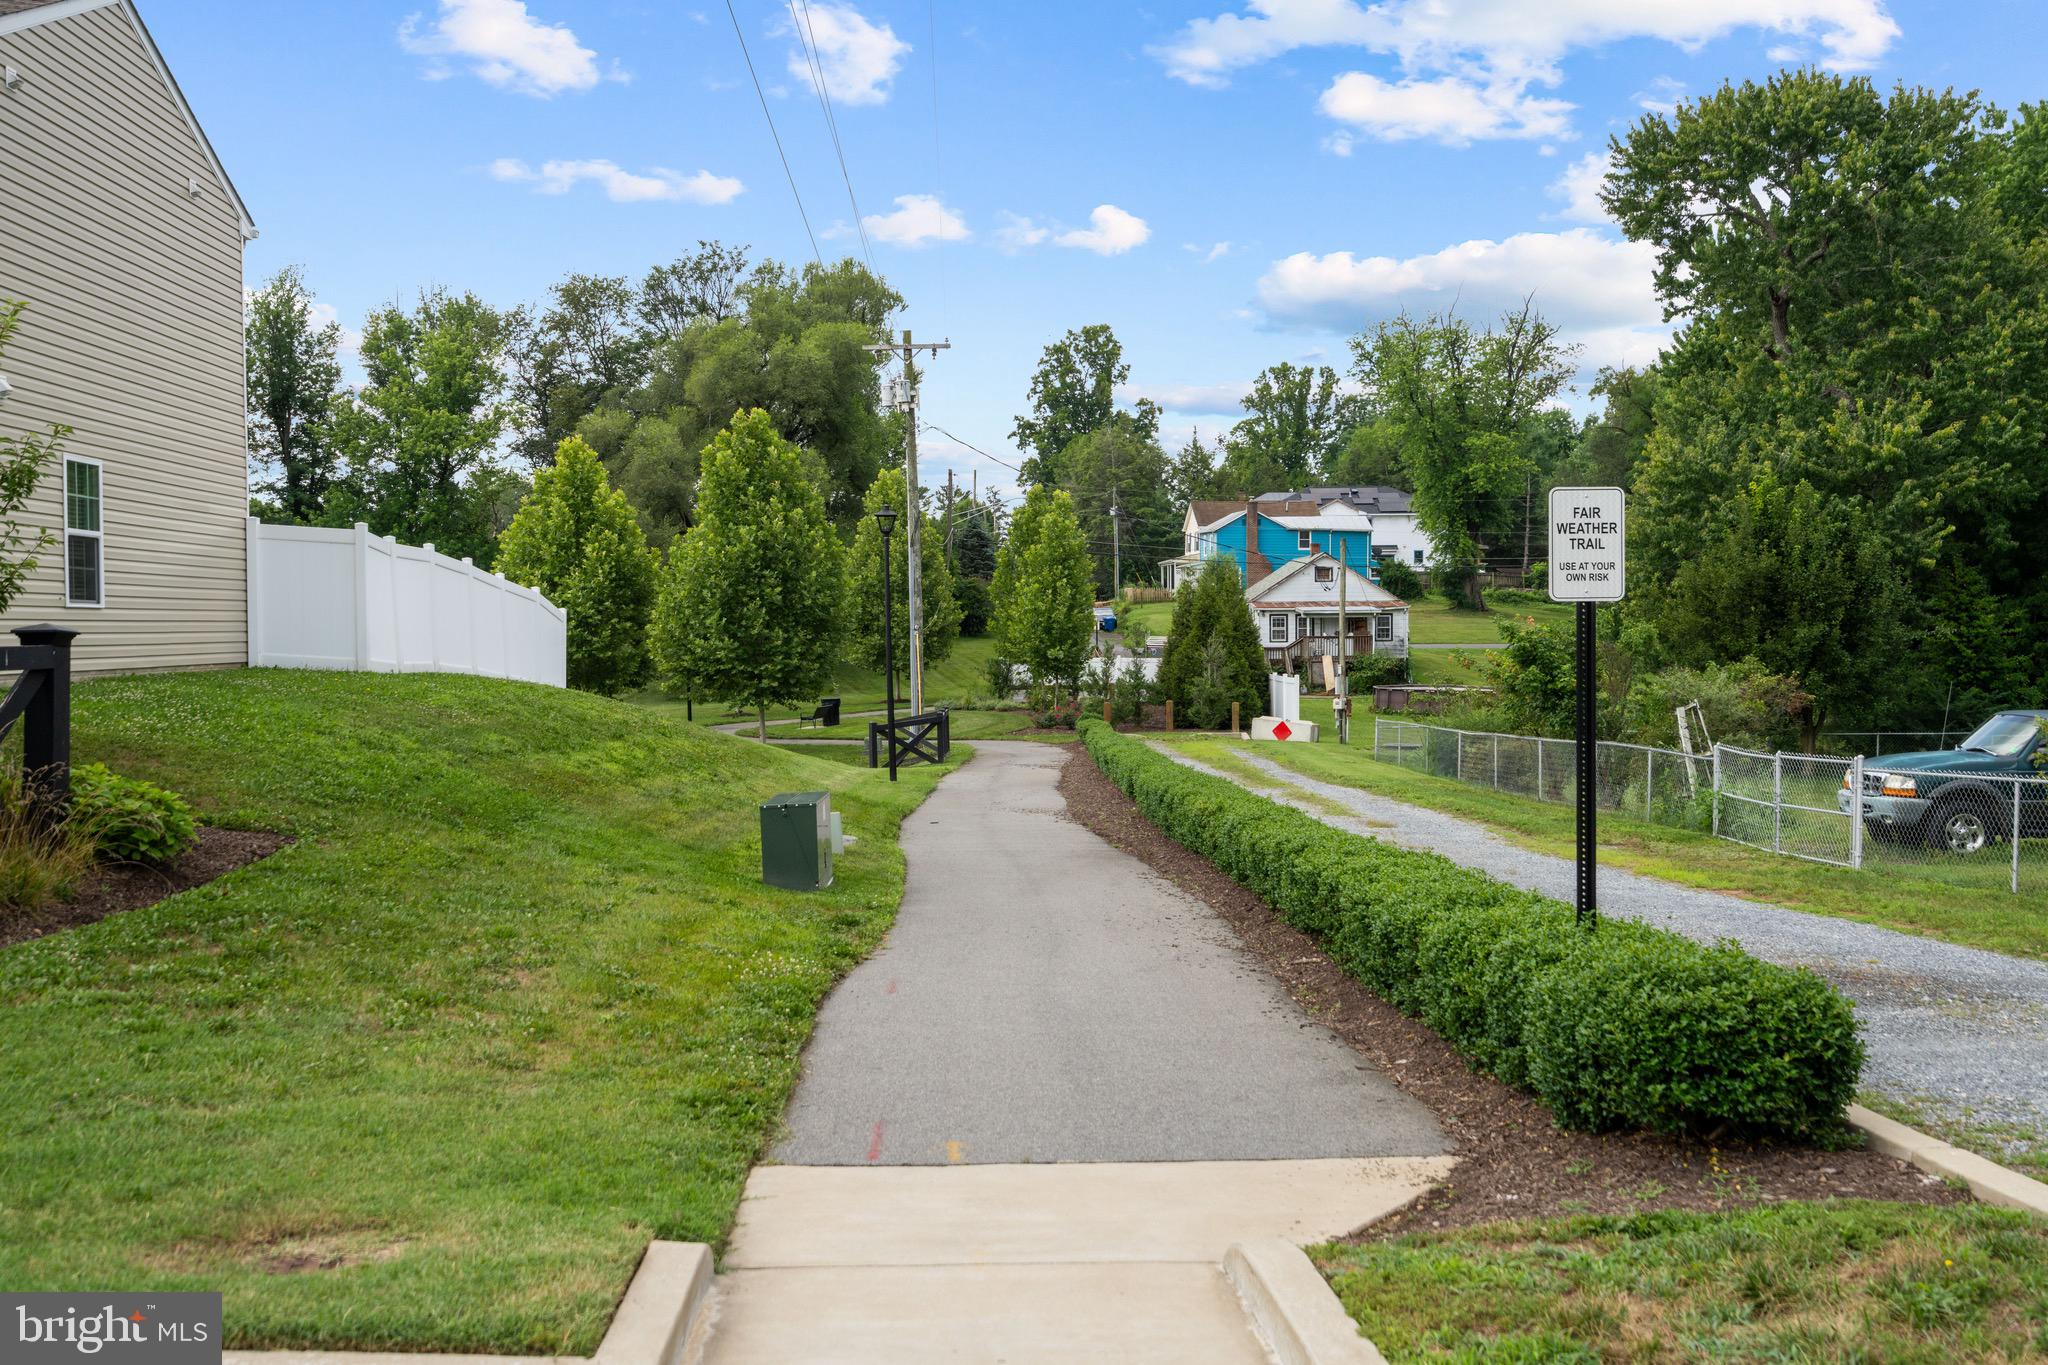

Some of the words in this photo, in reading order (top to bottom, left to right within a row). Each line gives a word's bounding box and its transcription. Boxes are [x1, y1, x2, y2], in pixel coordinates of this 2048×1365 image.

[1573, 507, 1601, 519] FAIR
[1556, 522, 1618, 535] WEATHER
[1569, 538, 1605, 550] TRAIL
[1559, 562, 1576, 571] USE
[1578, 562, 1589, 571] AT
[1591, 562, 1616, 571] YOUR
[1565, 573, 1587, 582] OWN
[1589, 573, 1609, 582] RISK
